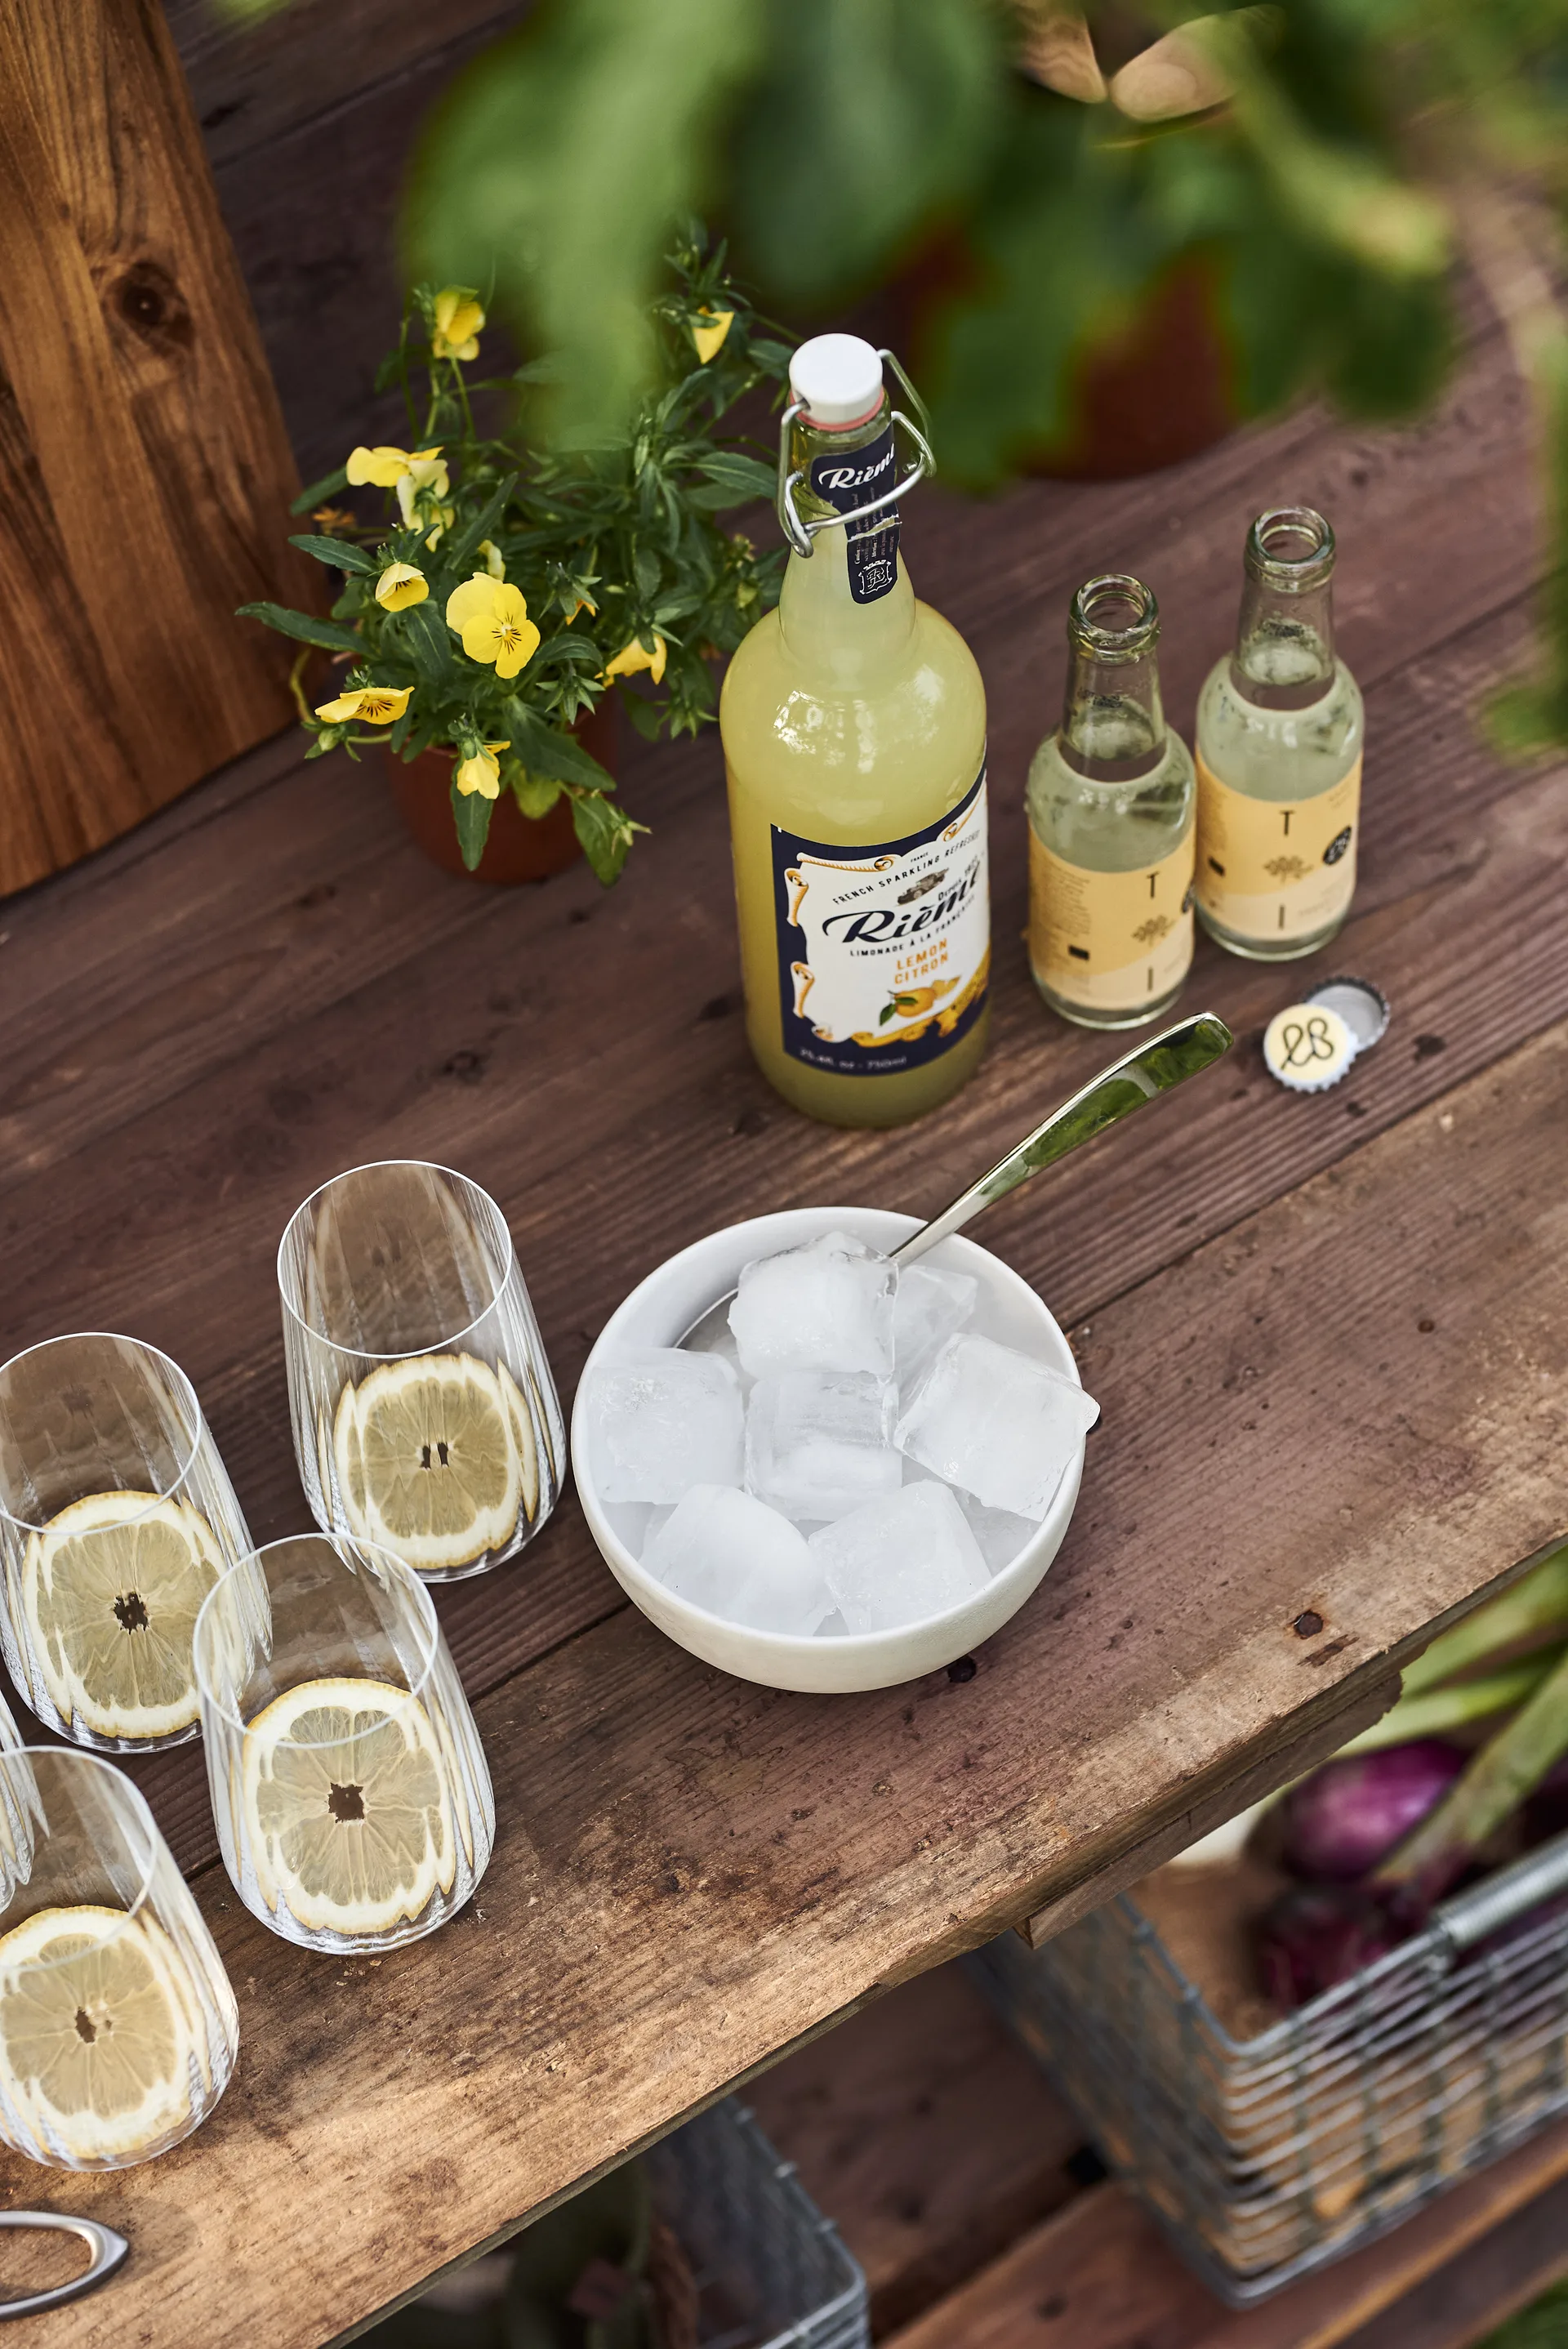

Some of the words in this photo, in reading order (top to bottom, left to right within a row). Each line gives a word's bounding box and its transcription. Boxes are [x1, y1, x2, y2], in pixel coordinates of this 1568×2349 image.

[1279, 810, 1296, 836] T
[832, 885, 875, 906] FRENCH
[878, 855, 941, 888] SPARKLING
[1147, 871, 1160, 898] T
[850, 944, 905, 957] LIMONADE
[920, 932, 931, 943] LA
[896, 938, 948, 970] LEMON
[894, 952, 949, 985] CITRON
